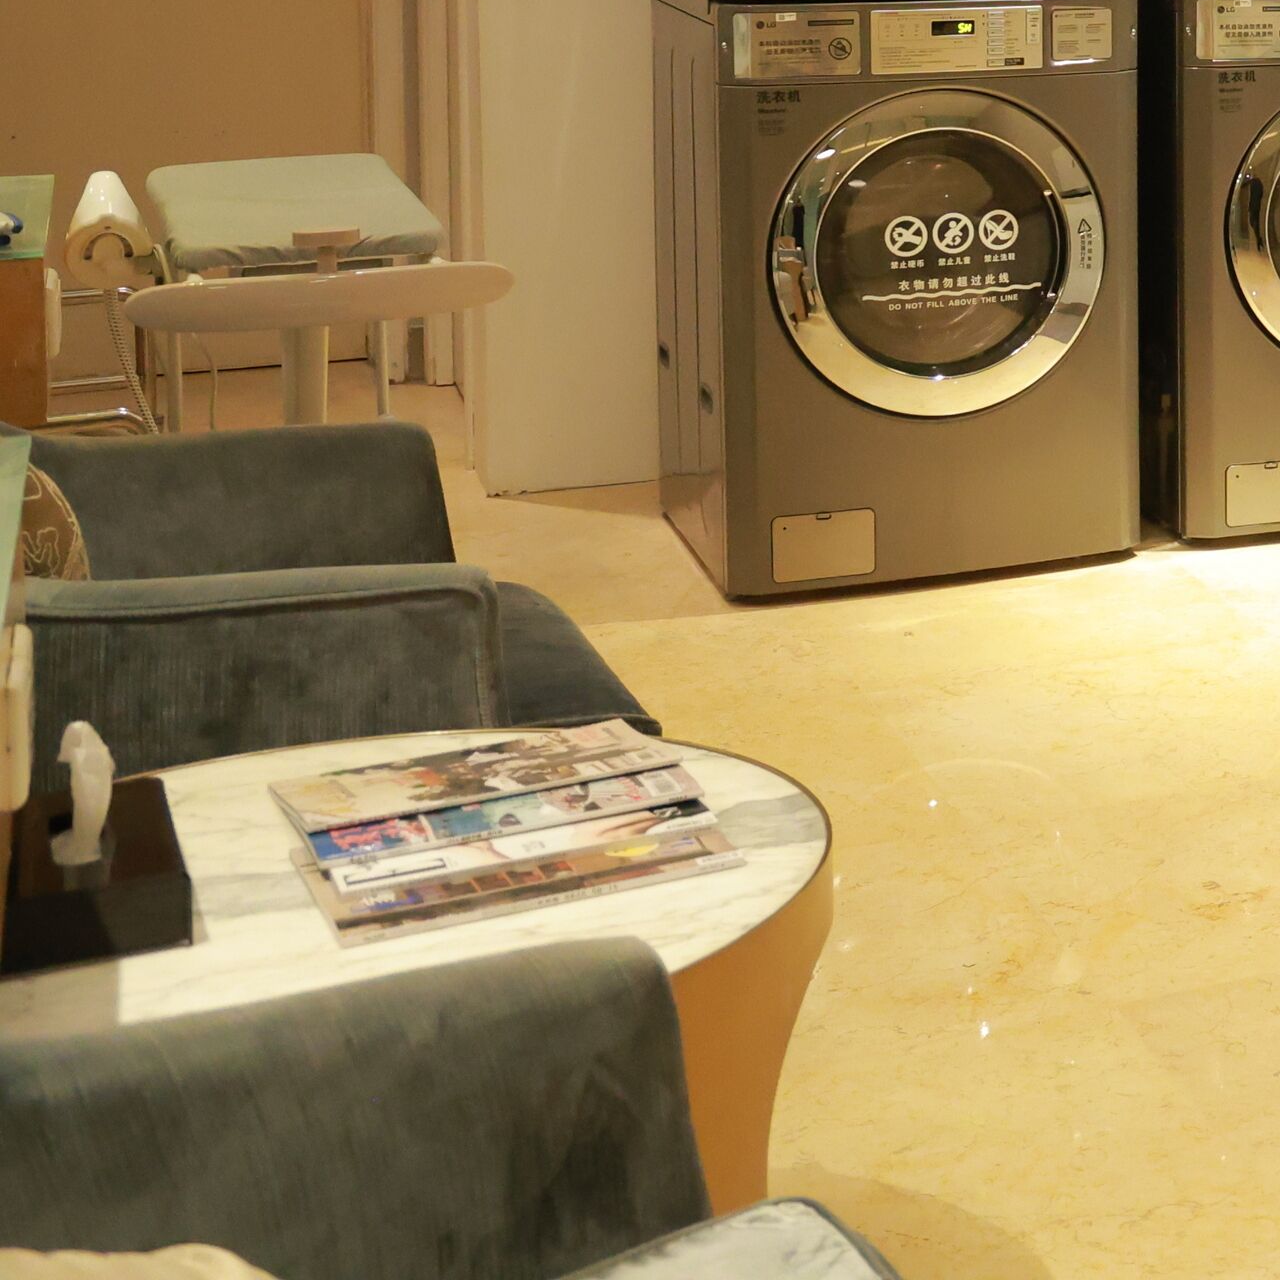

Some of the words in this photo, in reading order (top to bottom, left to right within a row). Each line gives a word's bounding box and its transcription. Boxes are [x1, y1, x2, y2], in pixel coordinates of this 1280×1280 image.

[1218, 71, 1256, 84] 洗衣机
[756, 90, 800, 104] 洗衣机
[891, 259, 924, 269] 禁止硬币
[938, 256, 970, 266] 禁止儿童
[899, 273, 1013, 294] 衣物请勿超过此线
[949, 298, 977, 308] ABOVE
[978, 295, 996, 303] THE
[1000, 294, 1018, 302] LINE
